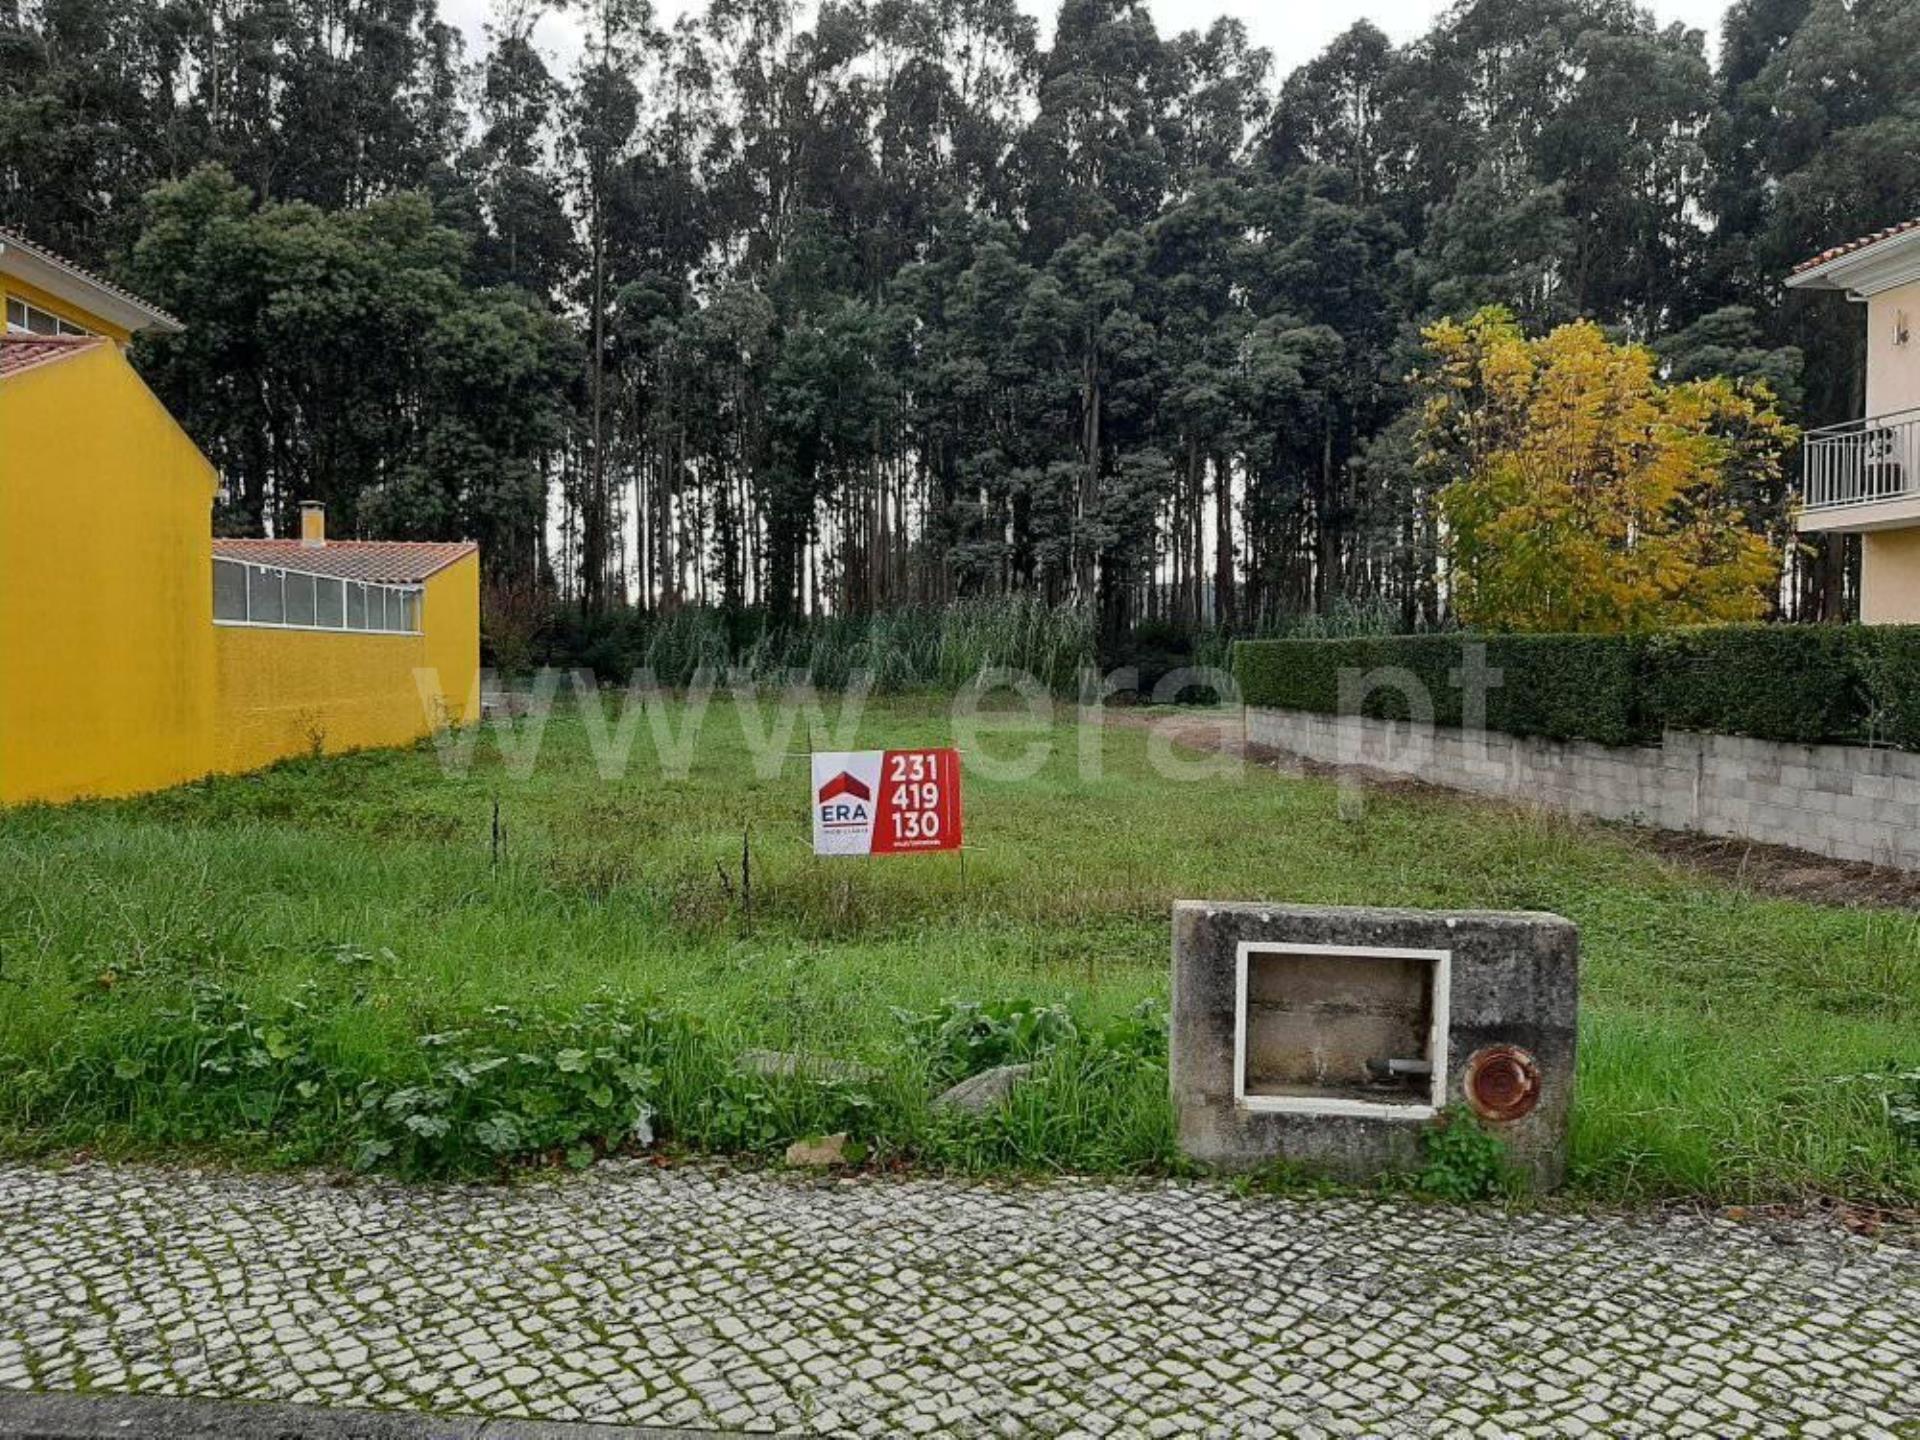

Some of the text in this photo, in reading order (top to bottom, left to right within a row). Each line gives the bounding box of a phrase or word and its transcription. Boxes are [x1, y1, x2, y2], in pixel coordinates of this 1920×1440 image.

[891, 754, 937, 782] 231
[891, 783, 940, 811] 419
[821, 804, 867, 822] ERA
[892, 811, 939, 839] 130
